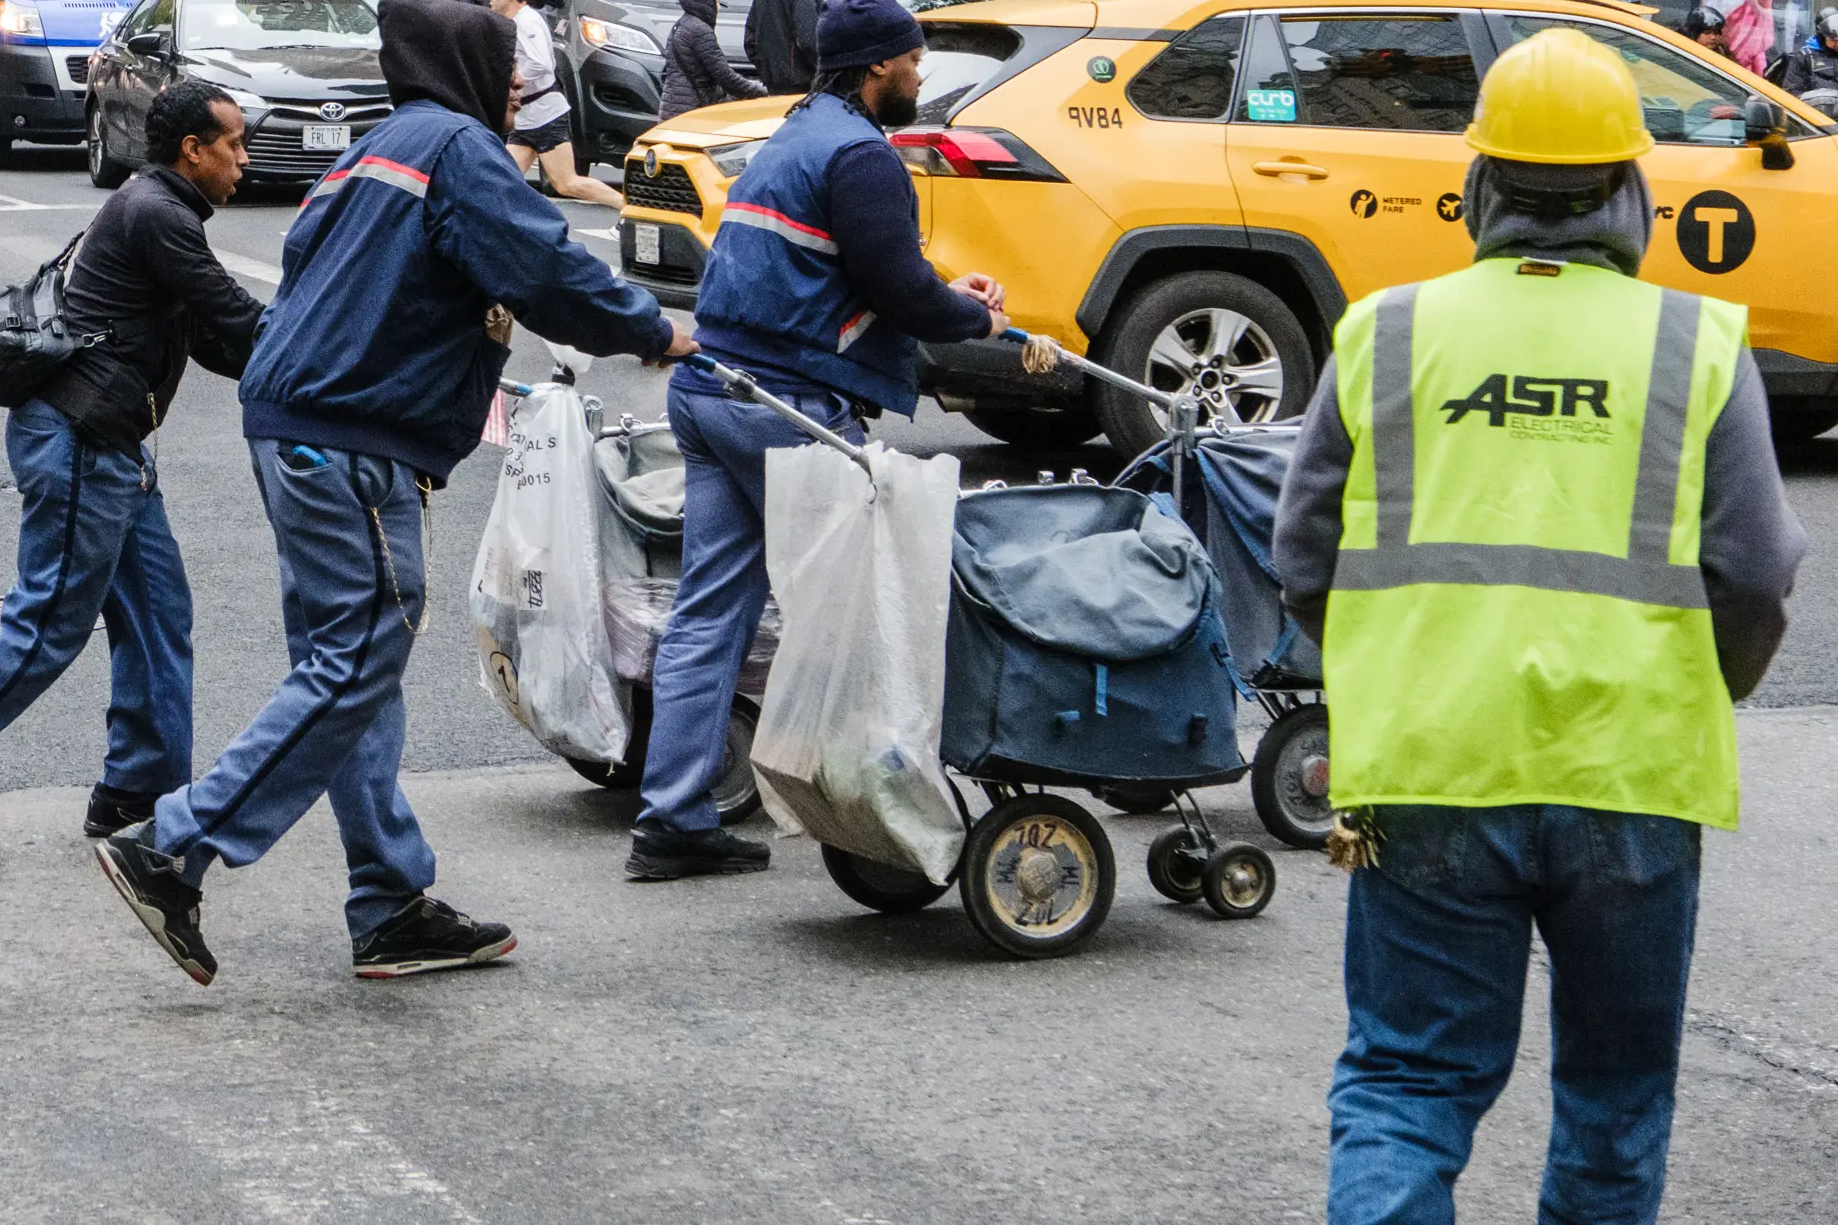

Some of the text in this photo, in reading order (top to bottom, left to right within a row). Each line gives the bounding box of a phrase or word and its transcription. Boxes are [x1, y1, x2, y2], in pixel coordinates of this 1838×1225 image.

[1247, 91, 1294, 106] curb
[1068, 106, 1123, 129] 9V84
[312, 132, 341, 145] FRL 17
[1382, 197, 1422, 206] METERED
[1382, 205, 1404, 214] FARE
[1653, 206, 1738, 263] YC T
[1439, 373, 1611, 427] ASR
[1511, 416, 1614, 435] ELECTRICAL
